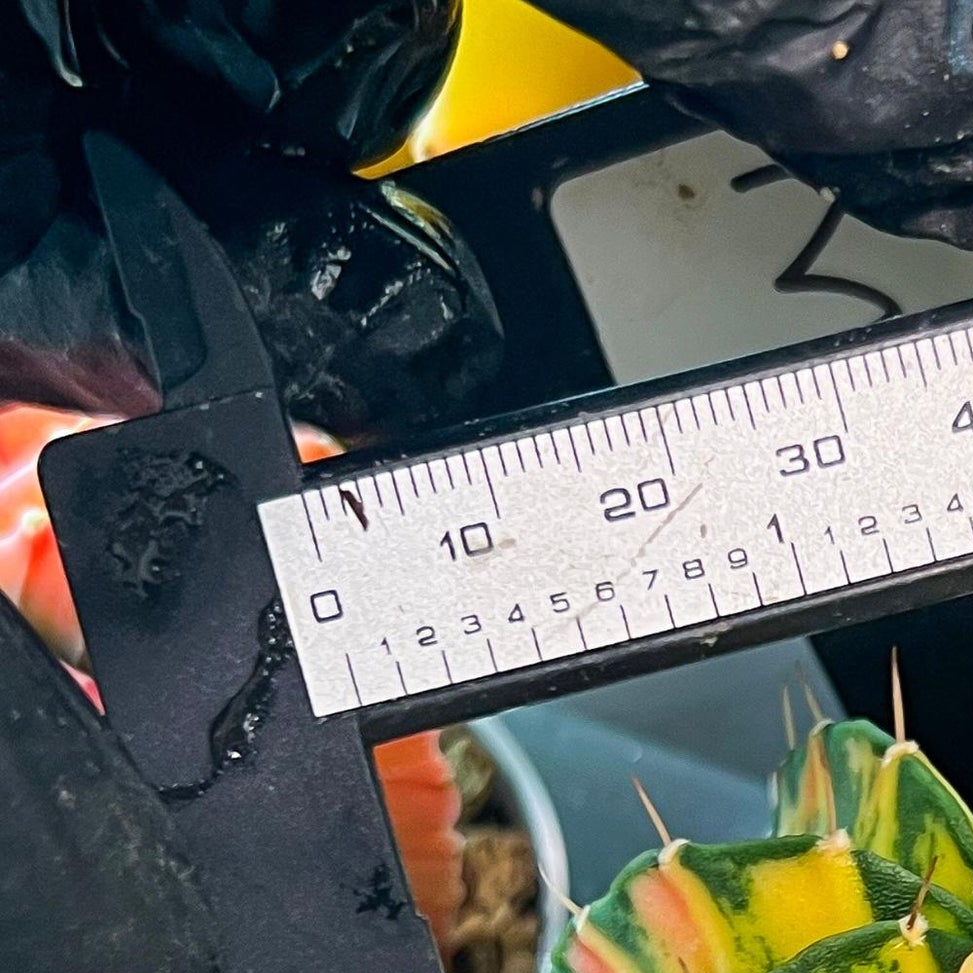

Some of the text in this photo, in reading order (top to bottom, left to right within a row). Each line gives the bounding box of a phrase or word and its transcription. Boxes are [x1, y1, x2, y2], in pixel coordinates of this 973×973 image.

[310, 590, 344, 623] 0
[440, 522, 494, 561] 10
[600, 478, 670, 523] 20
[776, 435, 845, 477] 30
[380, 636, 392, 656] 1
[415, 625, 439, 648] 2
[460, 614, 483, 636] 3
[507, 602, 526, 624] 4
[549, 591, 571, 614] 5
[594, 580, 616, 603] 6
[641, 568, 659, 591] 7
[681, 558, 706, 581] 8
[727, 547, 749, 570] 9
[766, 513, 785, 544] 1
[823, 525, 835, 545] 1
[857, 515, 880, 536] 2
[901, 503, 923, 525] 3
[945, 492, 966, 514] 4
